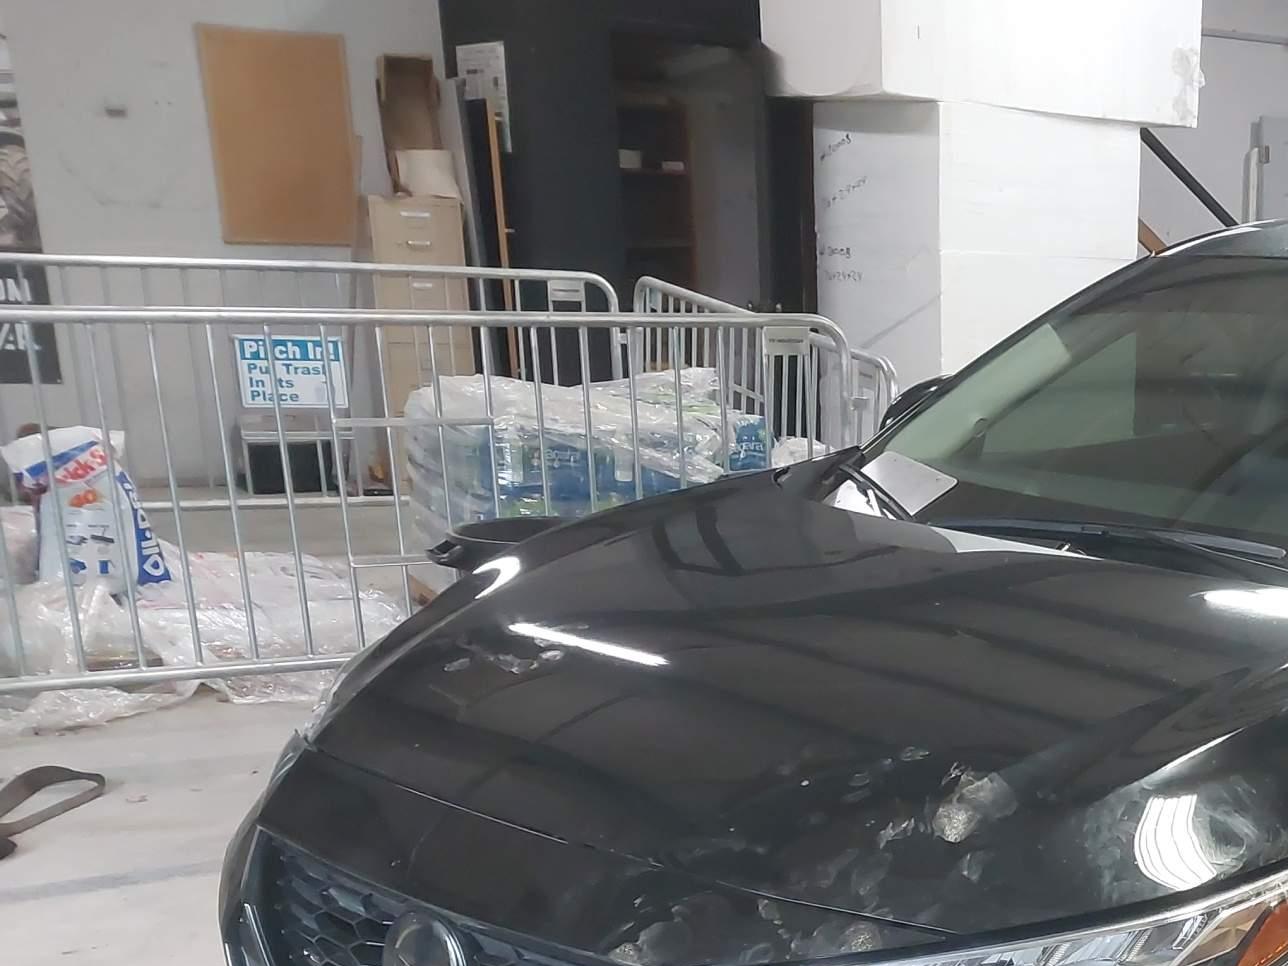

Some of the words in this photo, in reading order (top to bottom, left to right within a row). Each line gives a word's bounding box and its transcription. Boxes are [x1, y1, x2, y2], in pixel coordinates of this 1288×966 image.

[243, 340, 301, 360] Pich
[247, 362, 272, 375] Pu
[249, 376, 265, 388] In
[251, 390, 300, 402] Place
